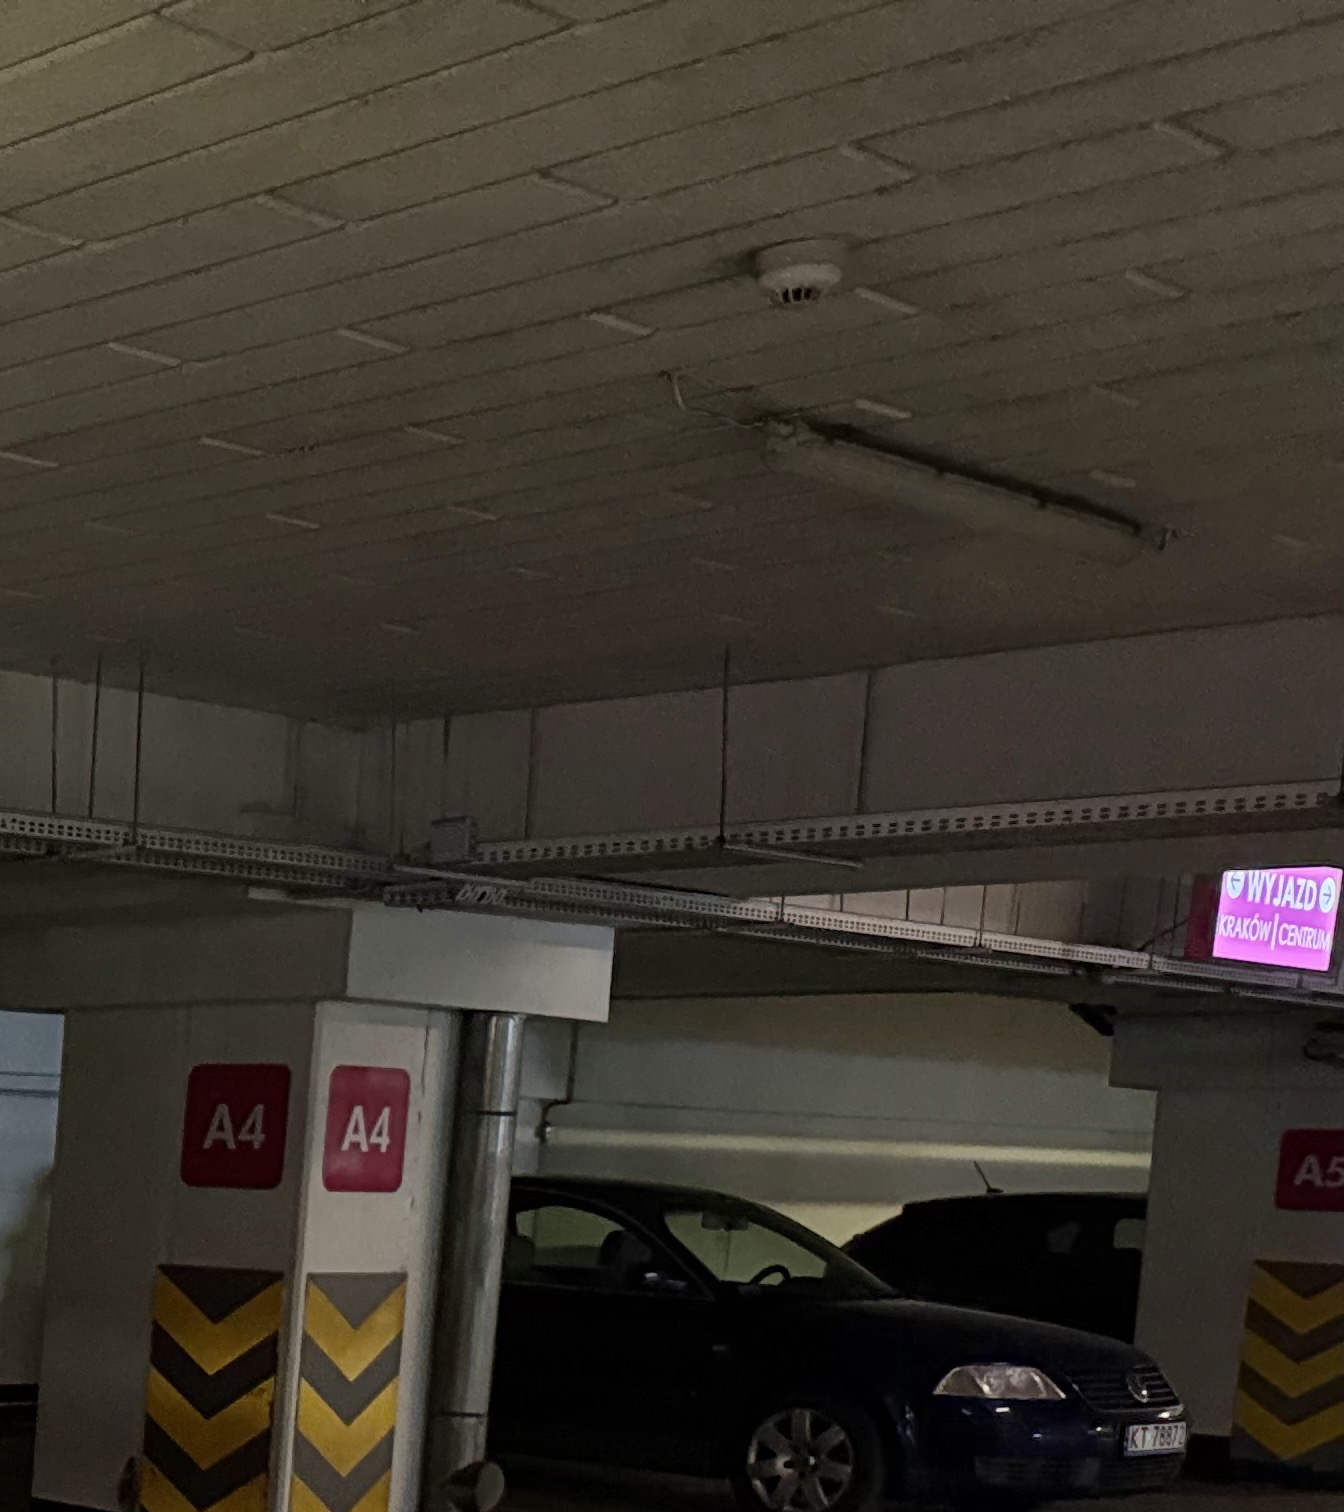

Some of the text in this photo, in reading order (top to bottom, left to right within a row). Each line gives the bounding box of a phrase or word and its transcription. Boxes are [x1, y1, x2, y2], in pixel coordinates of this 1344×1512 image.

[1247, 870, 1318, 911] WYJAZD
[1217, 913, 1330, 950] KRAKÓW CENTRUM
[202, 1103, 265, 1150] A4
[341, 1105, 391, 1153] A4
[1293, 1154, 1344, 1188] A5
